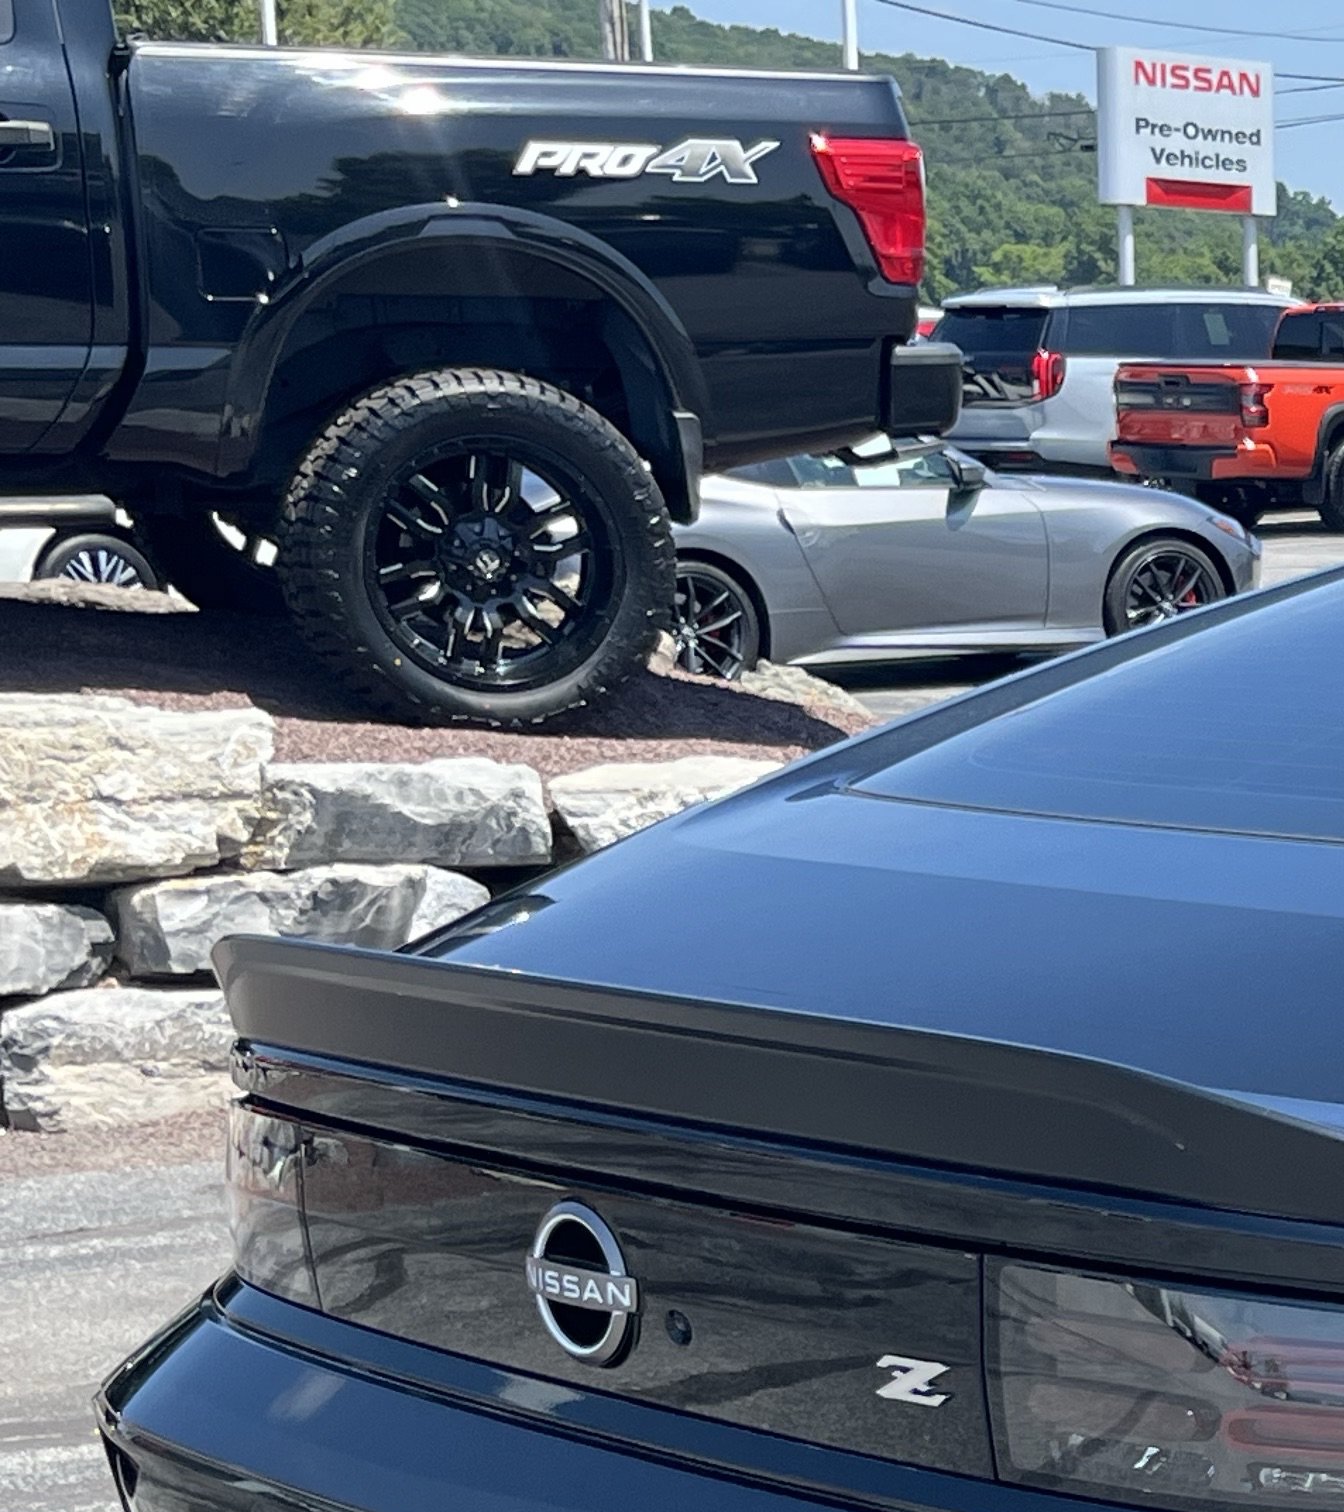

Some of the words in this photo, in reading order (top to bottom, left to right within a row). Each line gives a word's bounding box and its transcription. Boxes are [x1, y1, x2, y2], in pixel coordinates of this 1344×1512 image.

[1133, 60, 1260, 98] NISSAN
[1134, 117, 1262, 146] Pre-Owned
[1150, 147, 1248, 172] Vehicles
[527, 1262, 632, 1307] NISSAN
[875, 1354, 951, 1407] Z
